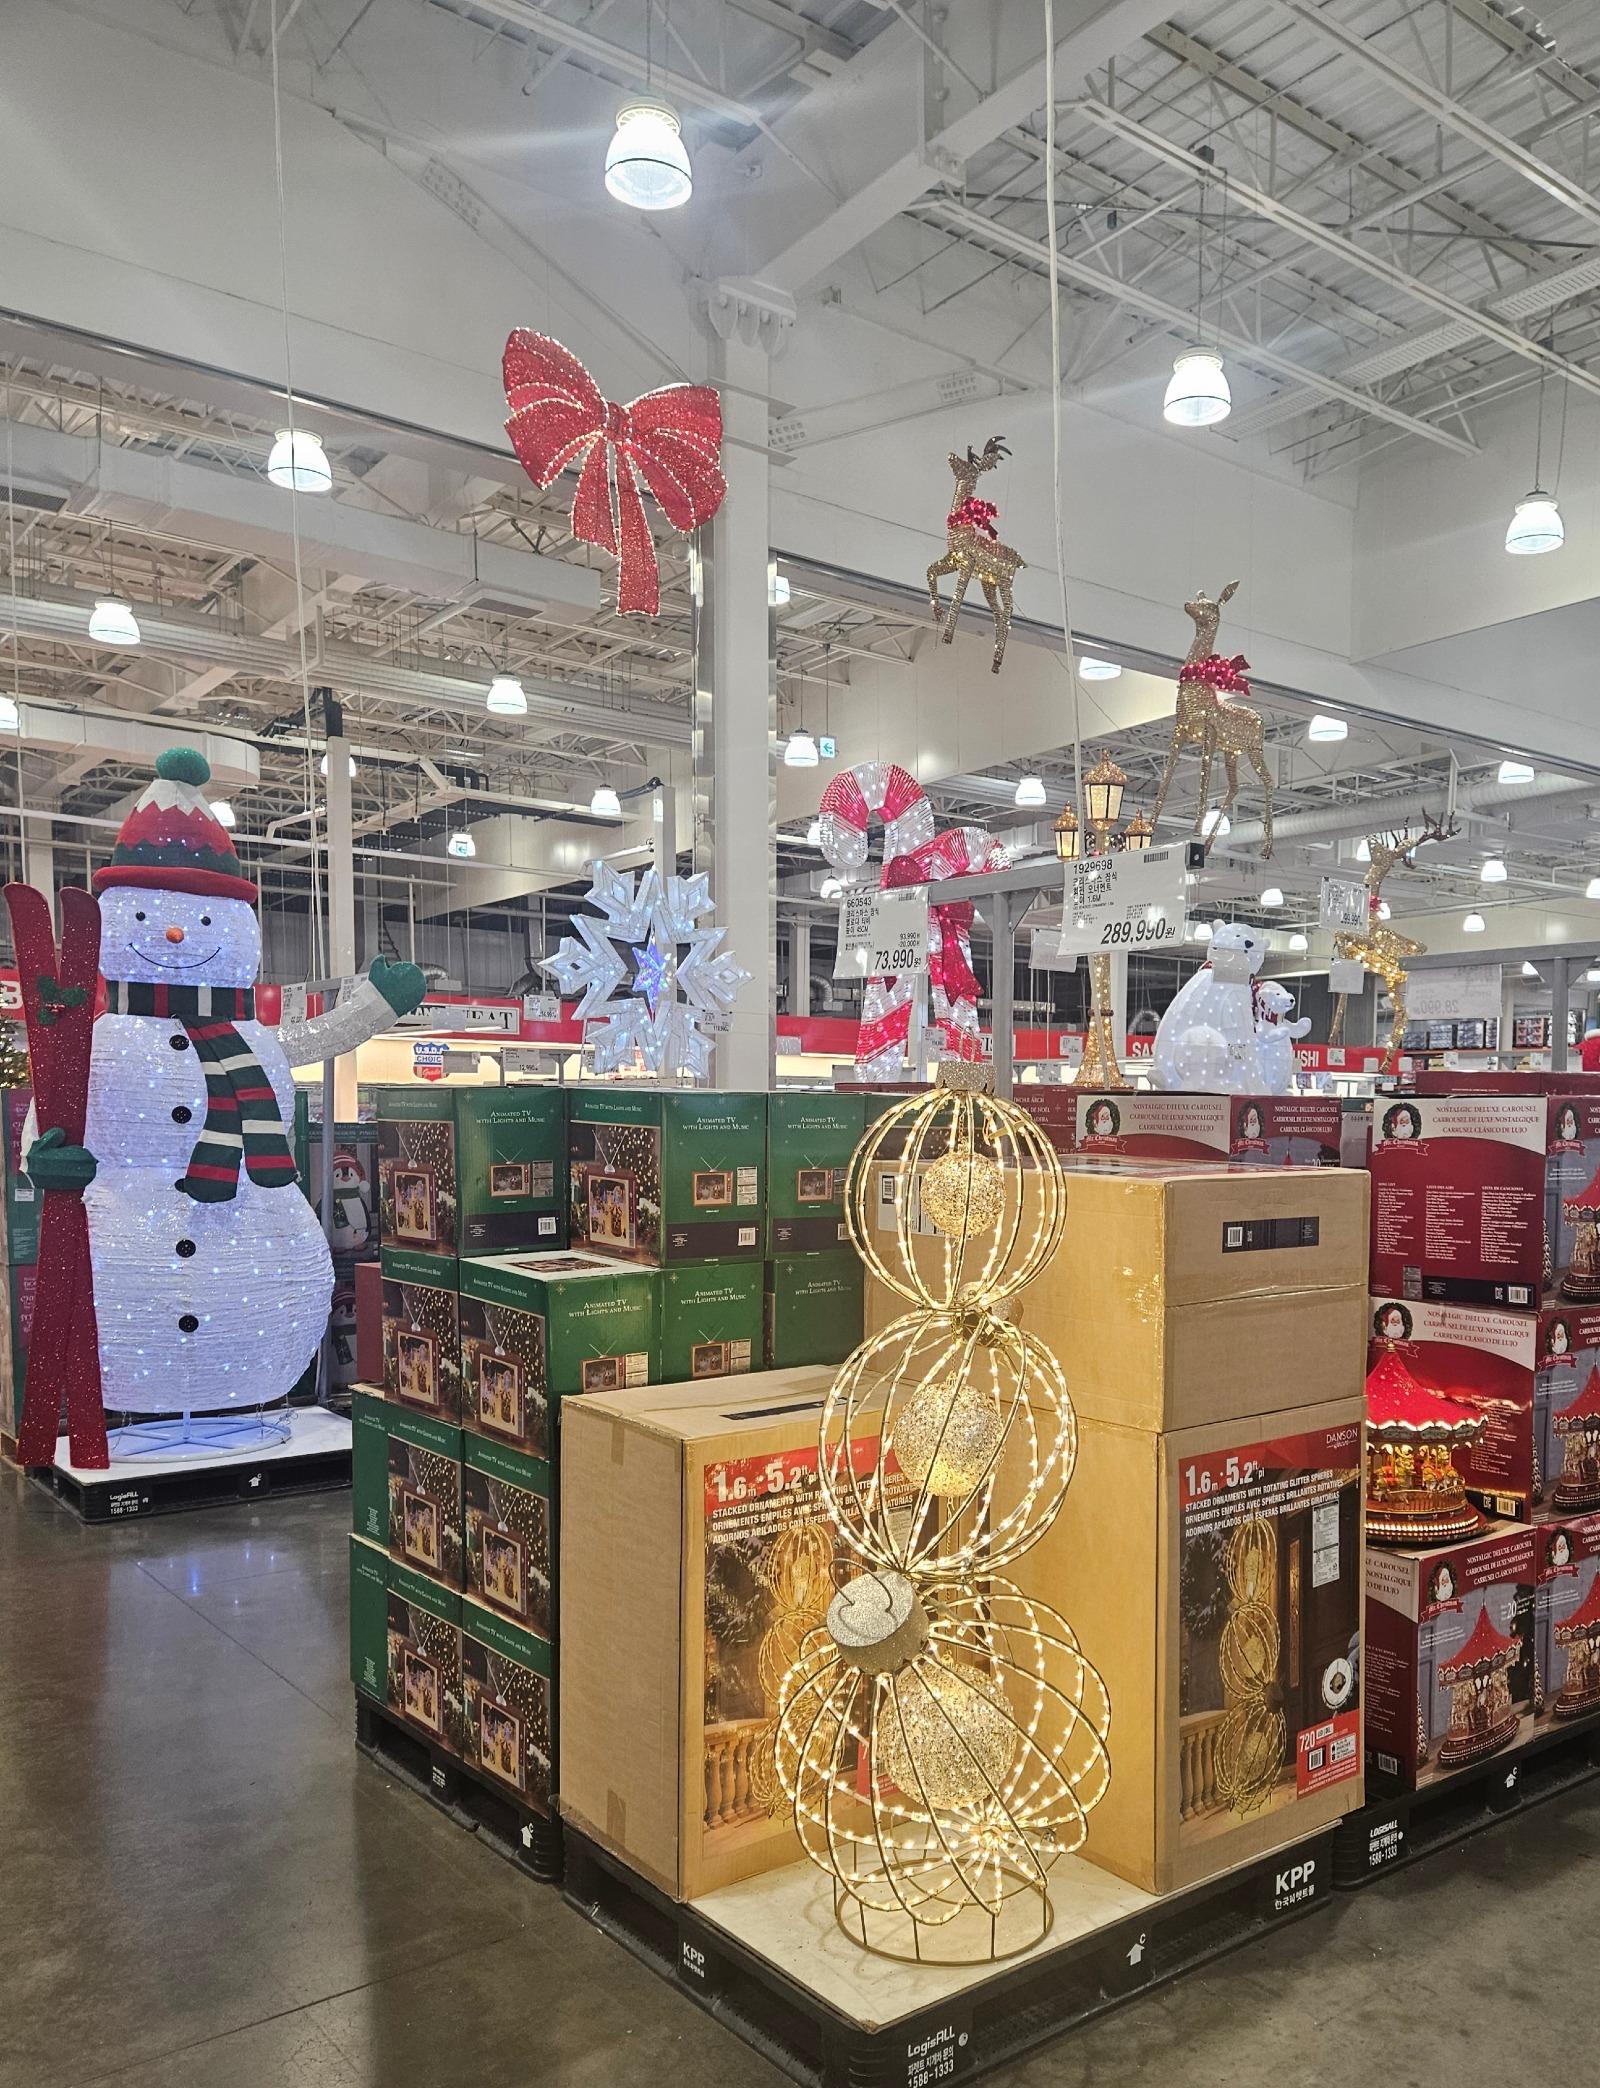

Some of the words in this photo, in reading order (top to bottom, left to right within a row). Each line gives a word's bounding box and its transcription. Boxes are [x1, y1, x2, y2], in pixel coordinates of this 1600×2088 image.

[1074, 859, 1112, 874] 1929698
[1326, 1428, 1358, 1444] DANSON
[1185, 1499, 1211, 1512] STACKED
[1212, 1490, 1246, 1508] ORNAMENTS
[1248, 1487, 1261, 1497] WITH
[1263, 1480, 1288, 1494] ROTATING
[1290, 1475, 1310, 1488] GLITTER
[1311, 1470, 1333, 1482] SPHERES
[1185, 1510, 1220, 1525] ORNEMENTS
[1222, 1502, 1245, 1516] EMPILÉS
[1246, 1500, 1260, 1510] AVEC
[1262, 1493, 1285, 1507] SPHÈRES
[1286, 1486, 1316, 1501] BRILLANTES
[1318, 1479, 1344, 1492] ROTATIVES
[713, 1504, 747, 1518] STACKED
[750, 1494, 794, 1512] ORNAMENTS
[796, 1491, 818, 1502] WITH
[1186, 1522, 1213, 1538] ADORNOS
[1214, 1514, 1242, 1531] APILADOS
[1243, 1514, 1254, 1524] CON
[1255, 1506, 1278, 1520] ESFERAS
[1279, 1500, 1310, 1514] BRILLANTES
[1311, 1491, 1340, 1506] GIRATORIAS
[713, 1516, 759, 1531] ORNEMENTS
[761, 1506, 792, 1523] EMPILÉS
[713, 1530, 749, 1544] ADORNOS
[1374, 1560, 1409, 1574] CAROUSEL
[1300, 1731, 1315, 1752] 720
[1370, 1844, 1397, 1866] 1588-1333
[1276, 1861, 1315, 1895] KPP
[684, 1942, 704, 1965] KPP
[908, 2026, 955, 2057] LogisALL
[943, 2045, 954, 2060] 문의
[908, 2059, 954, 2088] 1588-1333
